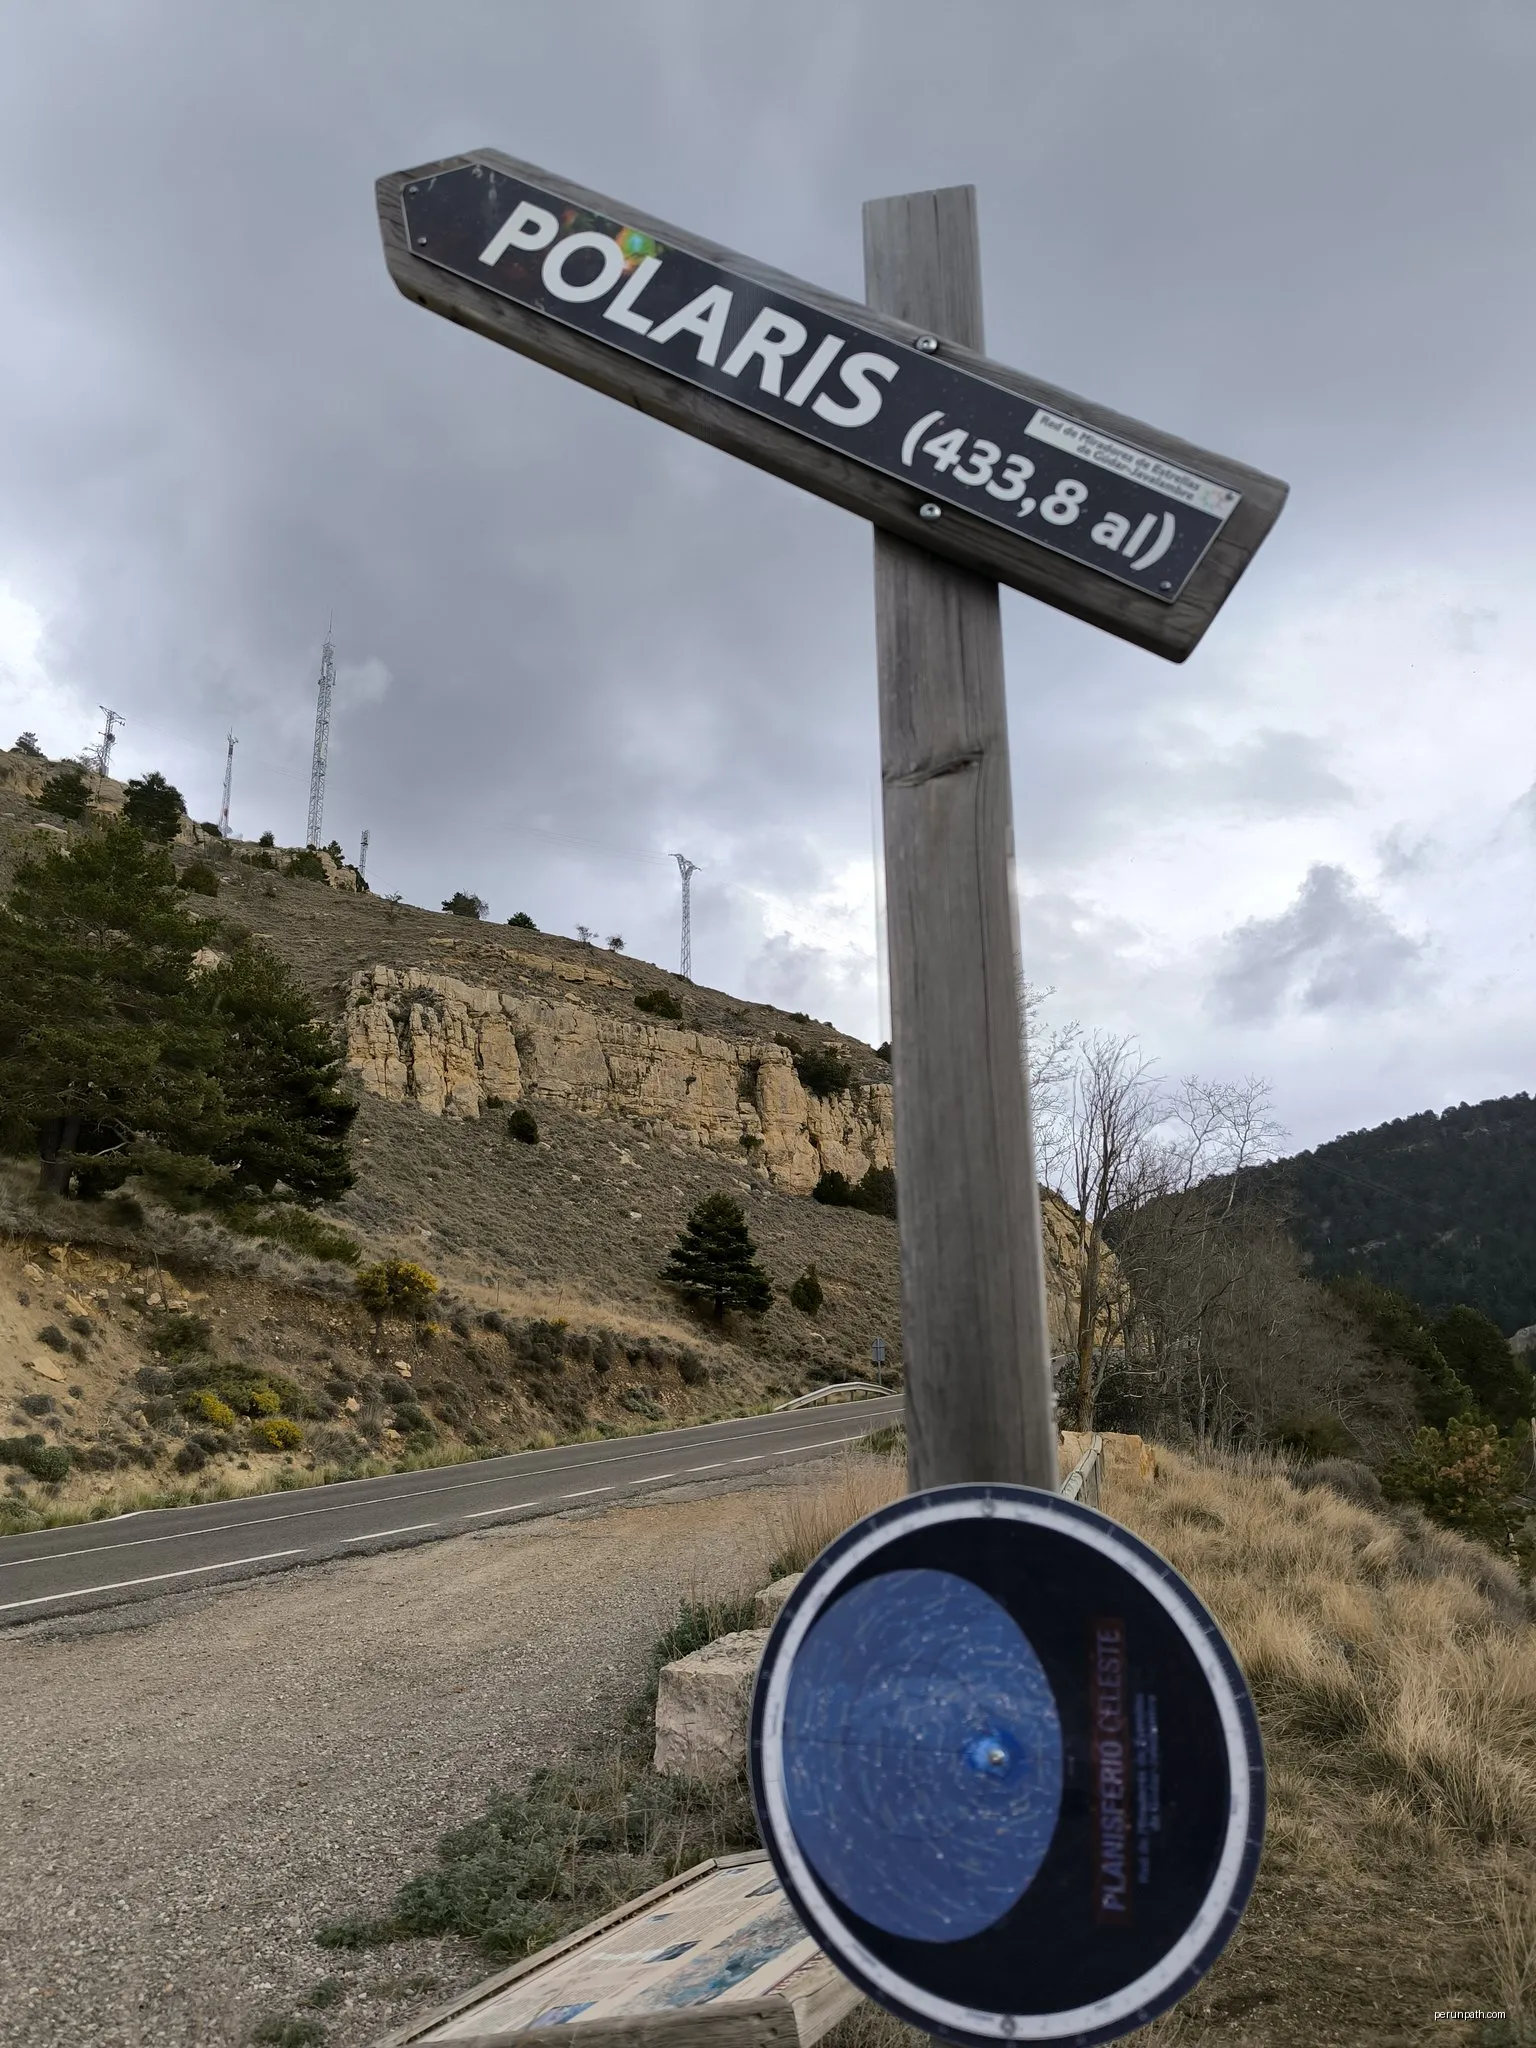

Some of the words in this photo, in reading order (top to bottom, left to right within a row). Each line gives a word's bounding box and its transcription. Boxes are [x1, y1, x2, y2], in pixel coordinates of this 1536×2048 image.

[478, 200, 900, 428] POLARIS
[901, 411, 1088, 526] (433,8
[1091, 511, 1176, 571] al)
[1040, 416, 1062, 431] Red
[1063, 428, 1078, 439] de
[1135, 457, 1150, 470] de
[1153, 463, 1200, 491] Estrellas
[1097, 1628, 1123, 1733] CELESTE
[1099, 1740, 1126, 1911] PLANISFERIO
